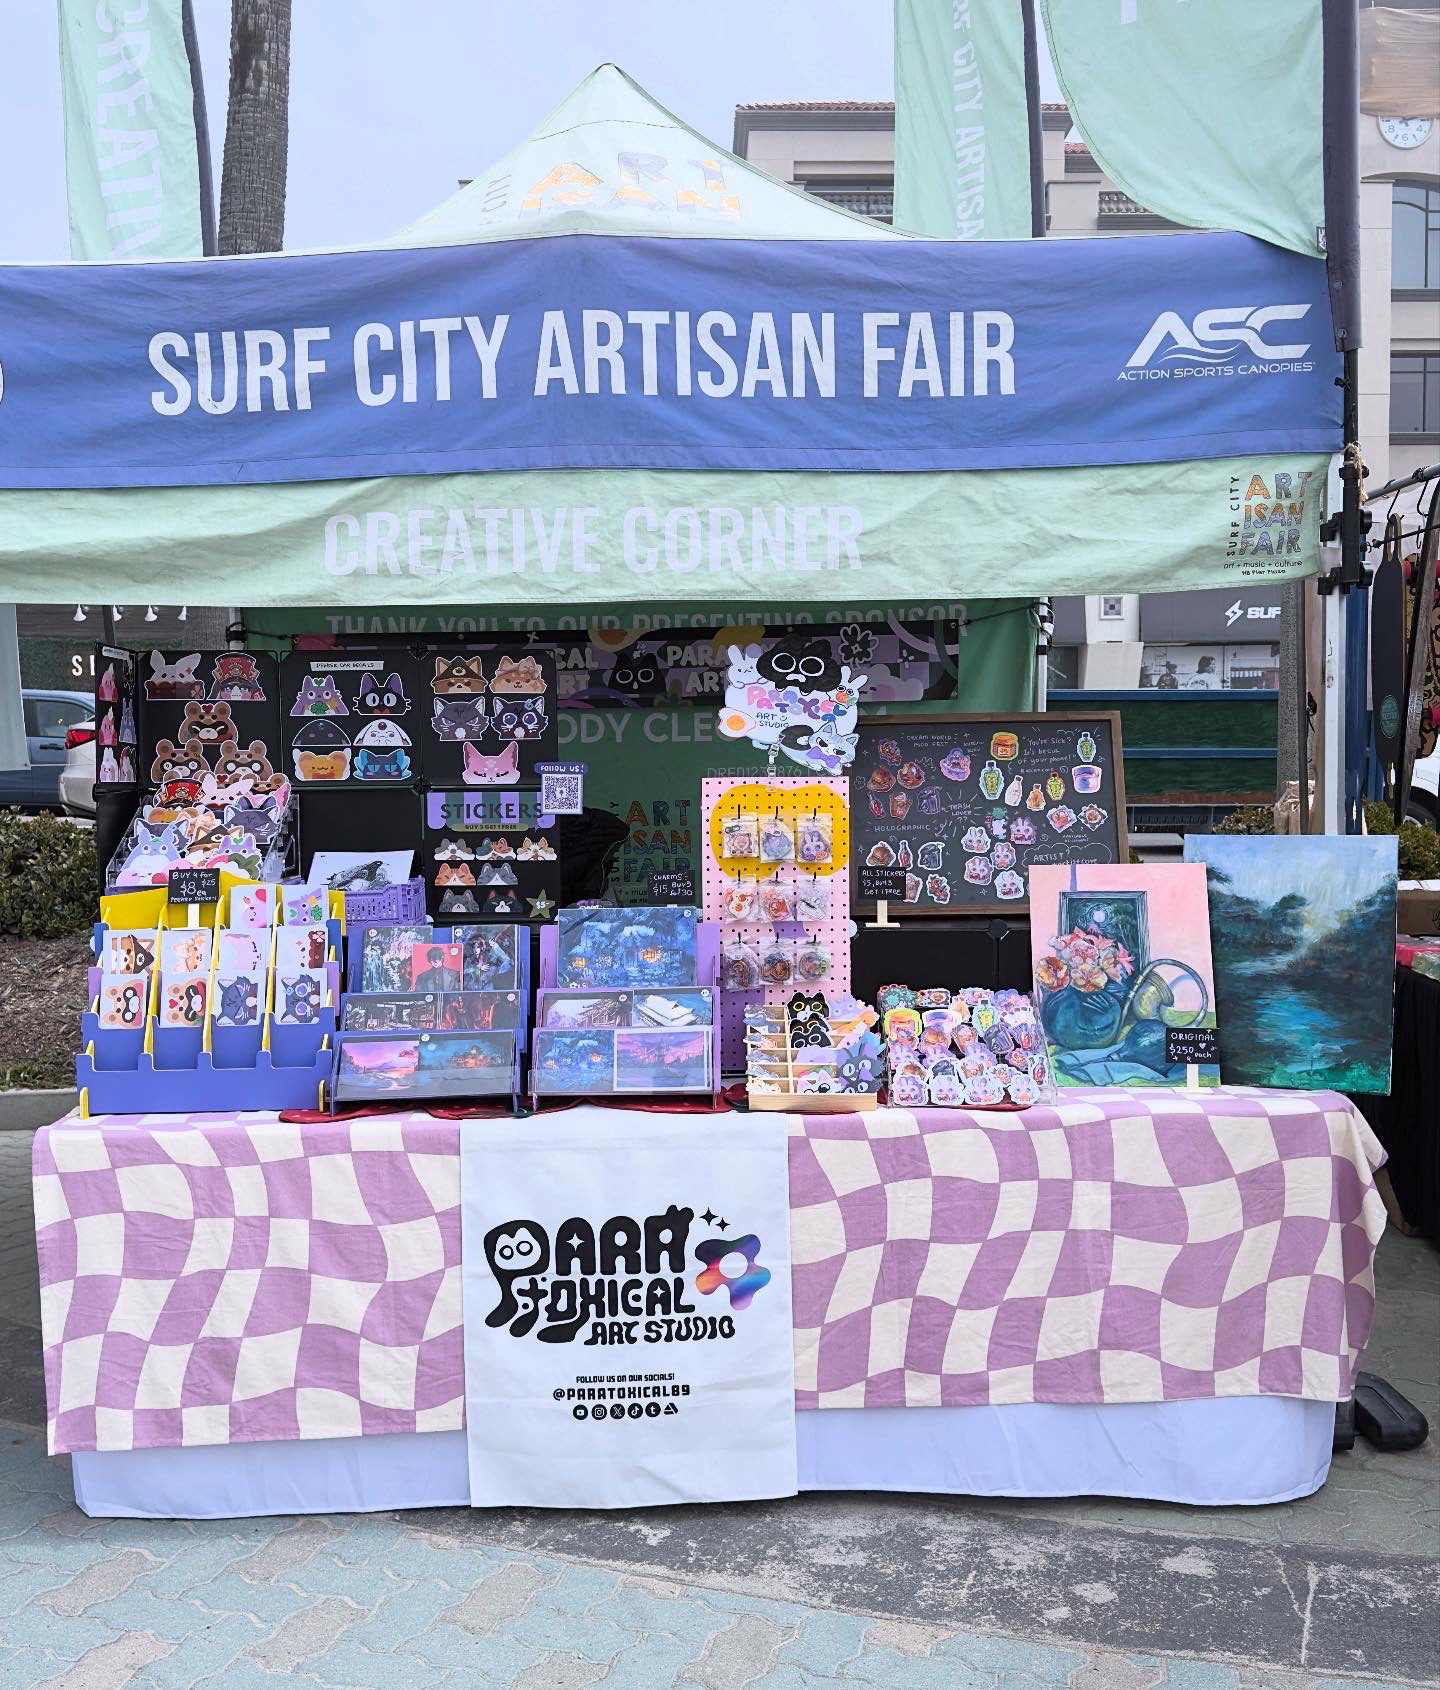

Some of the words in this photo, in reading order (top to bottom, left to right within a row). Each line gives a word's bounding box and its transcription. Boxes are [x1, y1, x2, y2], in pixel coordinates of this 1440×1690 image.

[953, 40, 984, 113] CITY
[1125, 303, 1312, 367] ASC
[148, 326, 331, 416] SURF
[353, 314, 510, 406] CITY
[534, 309, 836, 398] ARTISAN
[862, 310, 1017, 397] FAIR
[1117, 368, 1171, 381] ACTION
[1173, 365, 1234, 379] SPORTS
[1237, 361, 1313, 375] CANOPIES
[1229, 476, 1240, 511] CITY
[1244, 471, 1313, 501] ART
[1243, 500, 1305, 530] ISAN
[324, 507, 600, 576] CREATIVE
[622, 506, 864, 573] CORNER
[1226, 521, 1240, 557] SURF
[1238, 528, 1302, 556] FAIR
[1274, 559, 1303, 568] culture
[440, 803, 544, 820] STICKERS
[201, 878, 216, 888] $25
[862, 869, 874, 877] ALL
[180, 881, 197, 897] $8
[1169, 1043, 1195, 1056] $250
[1170, 1032, 1215, 1041] ORIGINAL
[483, 1204, 695, 1329] PARA
[584, 1320, 638, 1346] ART
[643, 1314, 736, 1344] STUDIO
[576, 1375, 605, 1384] FOLLOW
[606, 1375, 616, 1383] US
[616, 1374, 627, 1383] ON
[628, 1374, 643, 1382] OUR
[643, 1372, 675, 1382] SOCIALS!
[553, 1384, 691, 1402] @PARATOXICAL89
